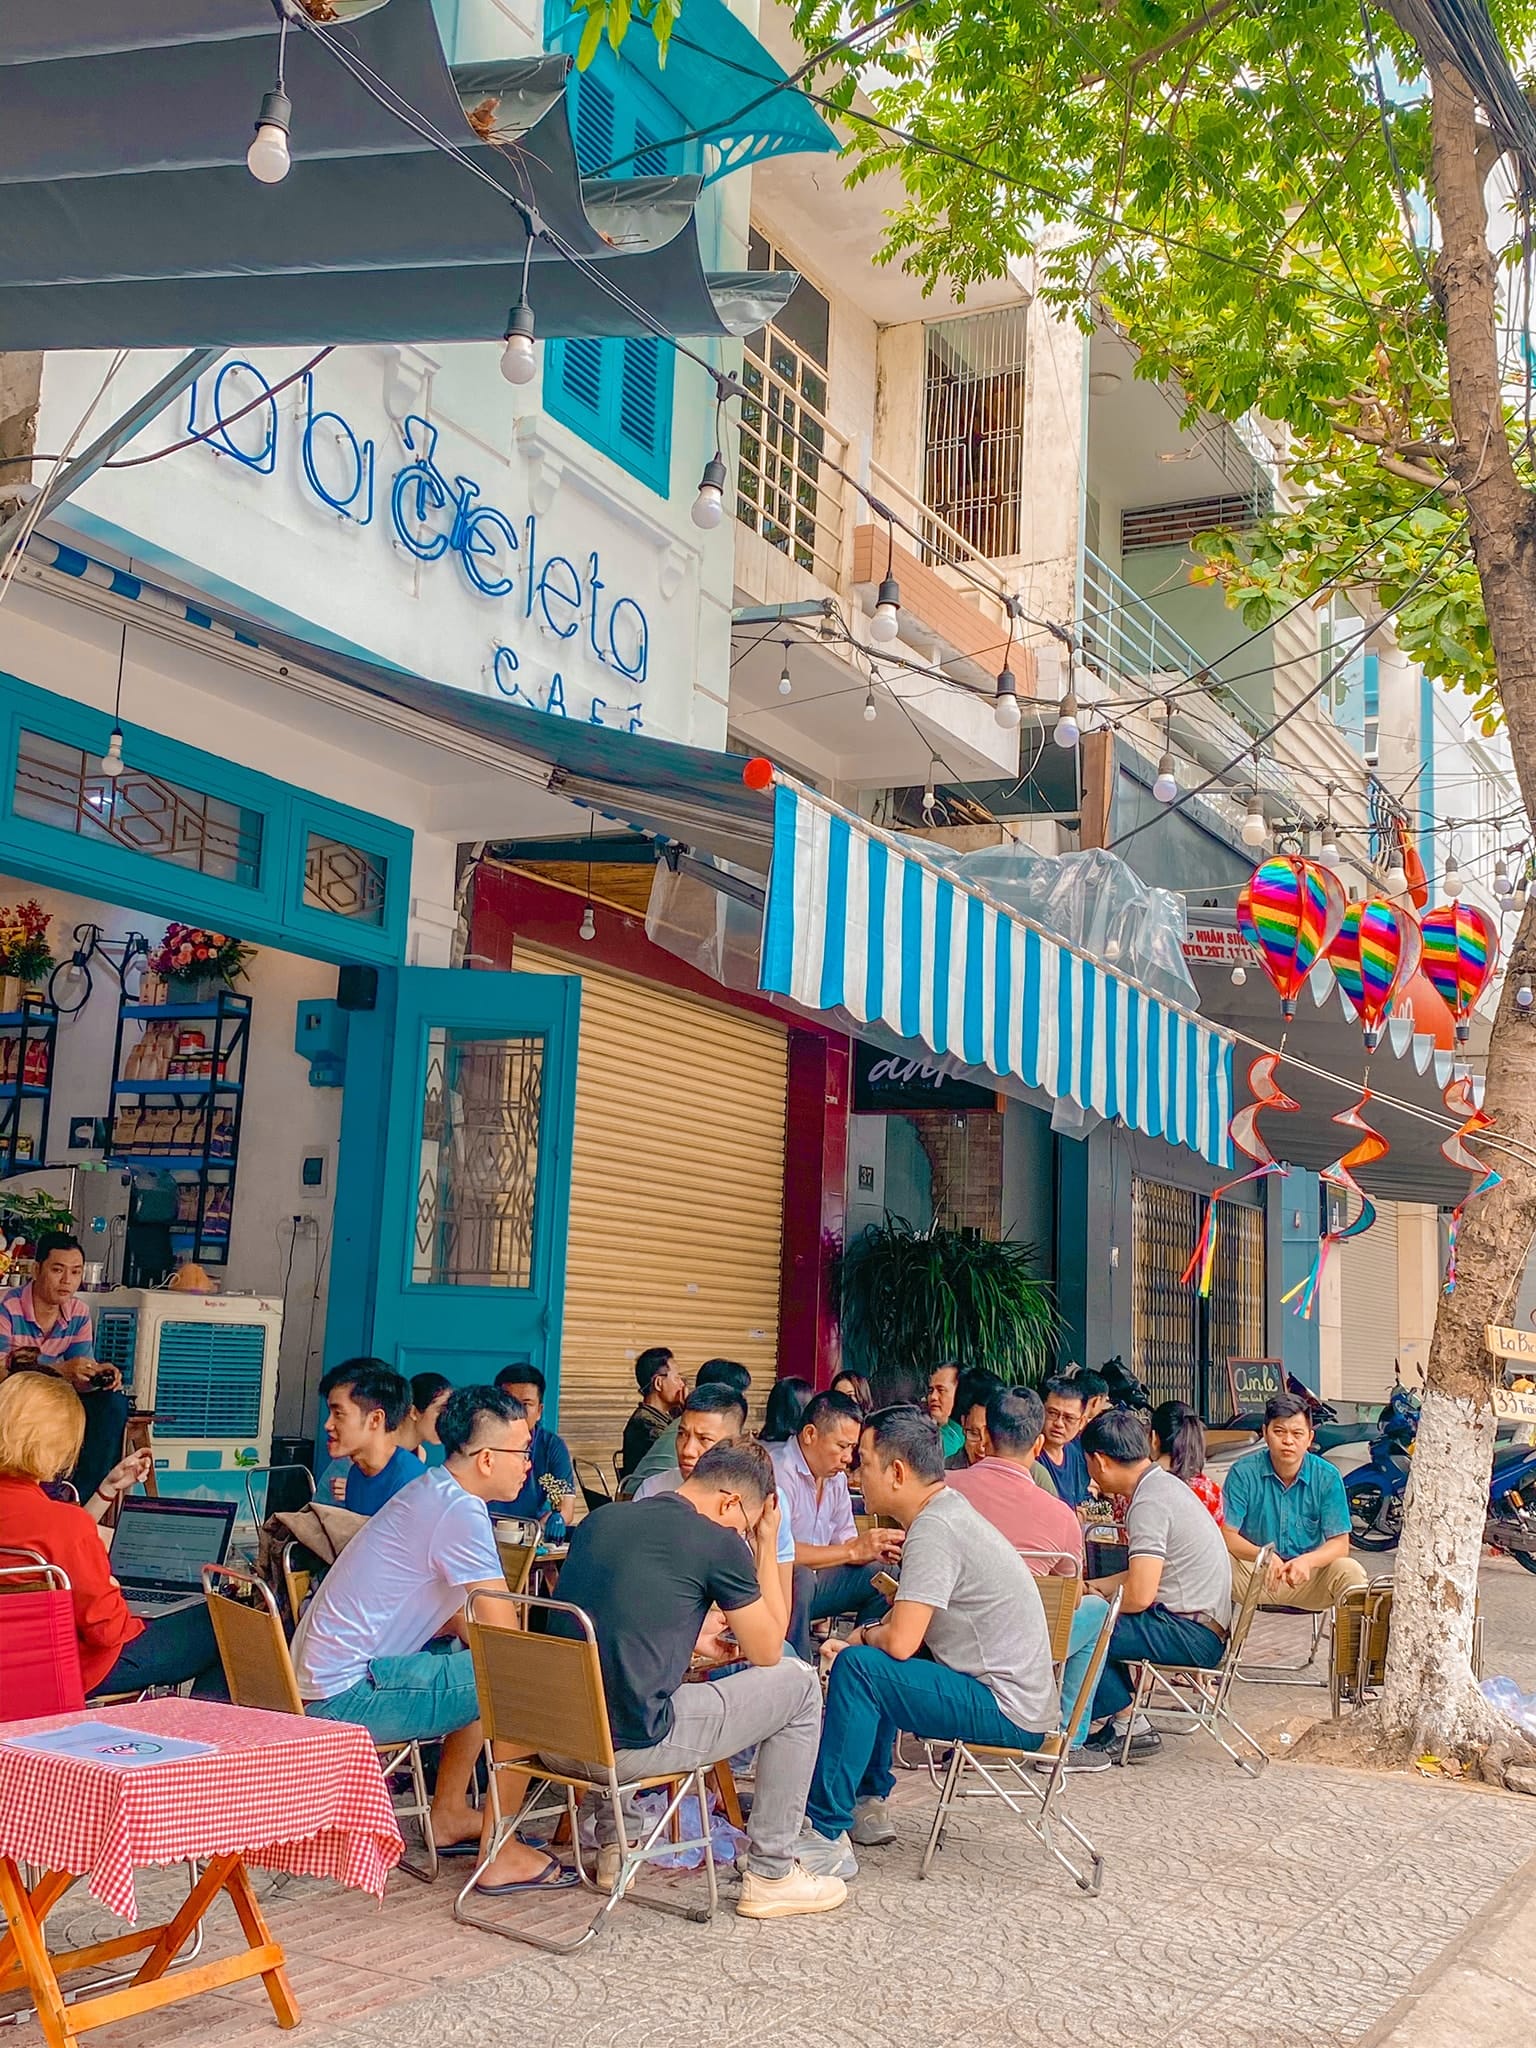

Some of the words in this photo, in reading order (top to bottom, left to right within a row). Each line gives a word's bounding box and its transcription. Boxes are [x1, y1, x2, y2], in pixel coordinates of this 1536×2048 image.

[1195, 929, 1225, 945] NHÂN
[860, 1168, 872, 1184] 37
[1499, 1328, 1515, 1352] La
[1495, 1391, 1518, 1414] 33
